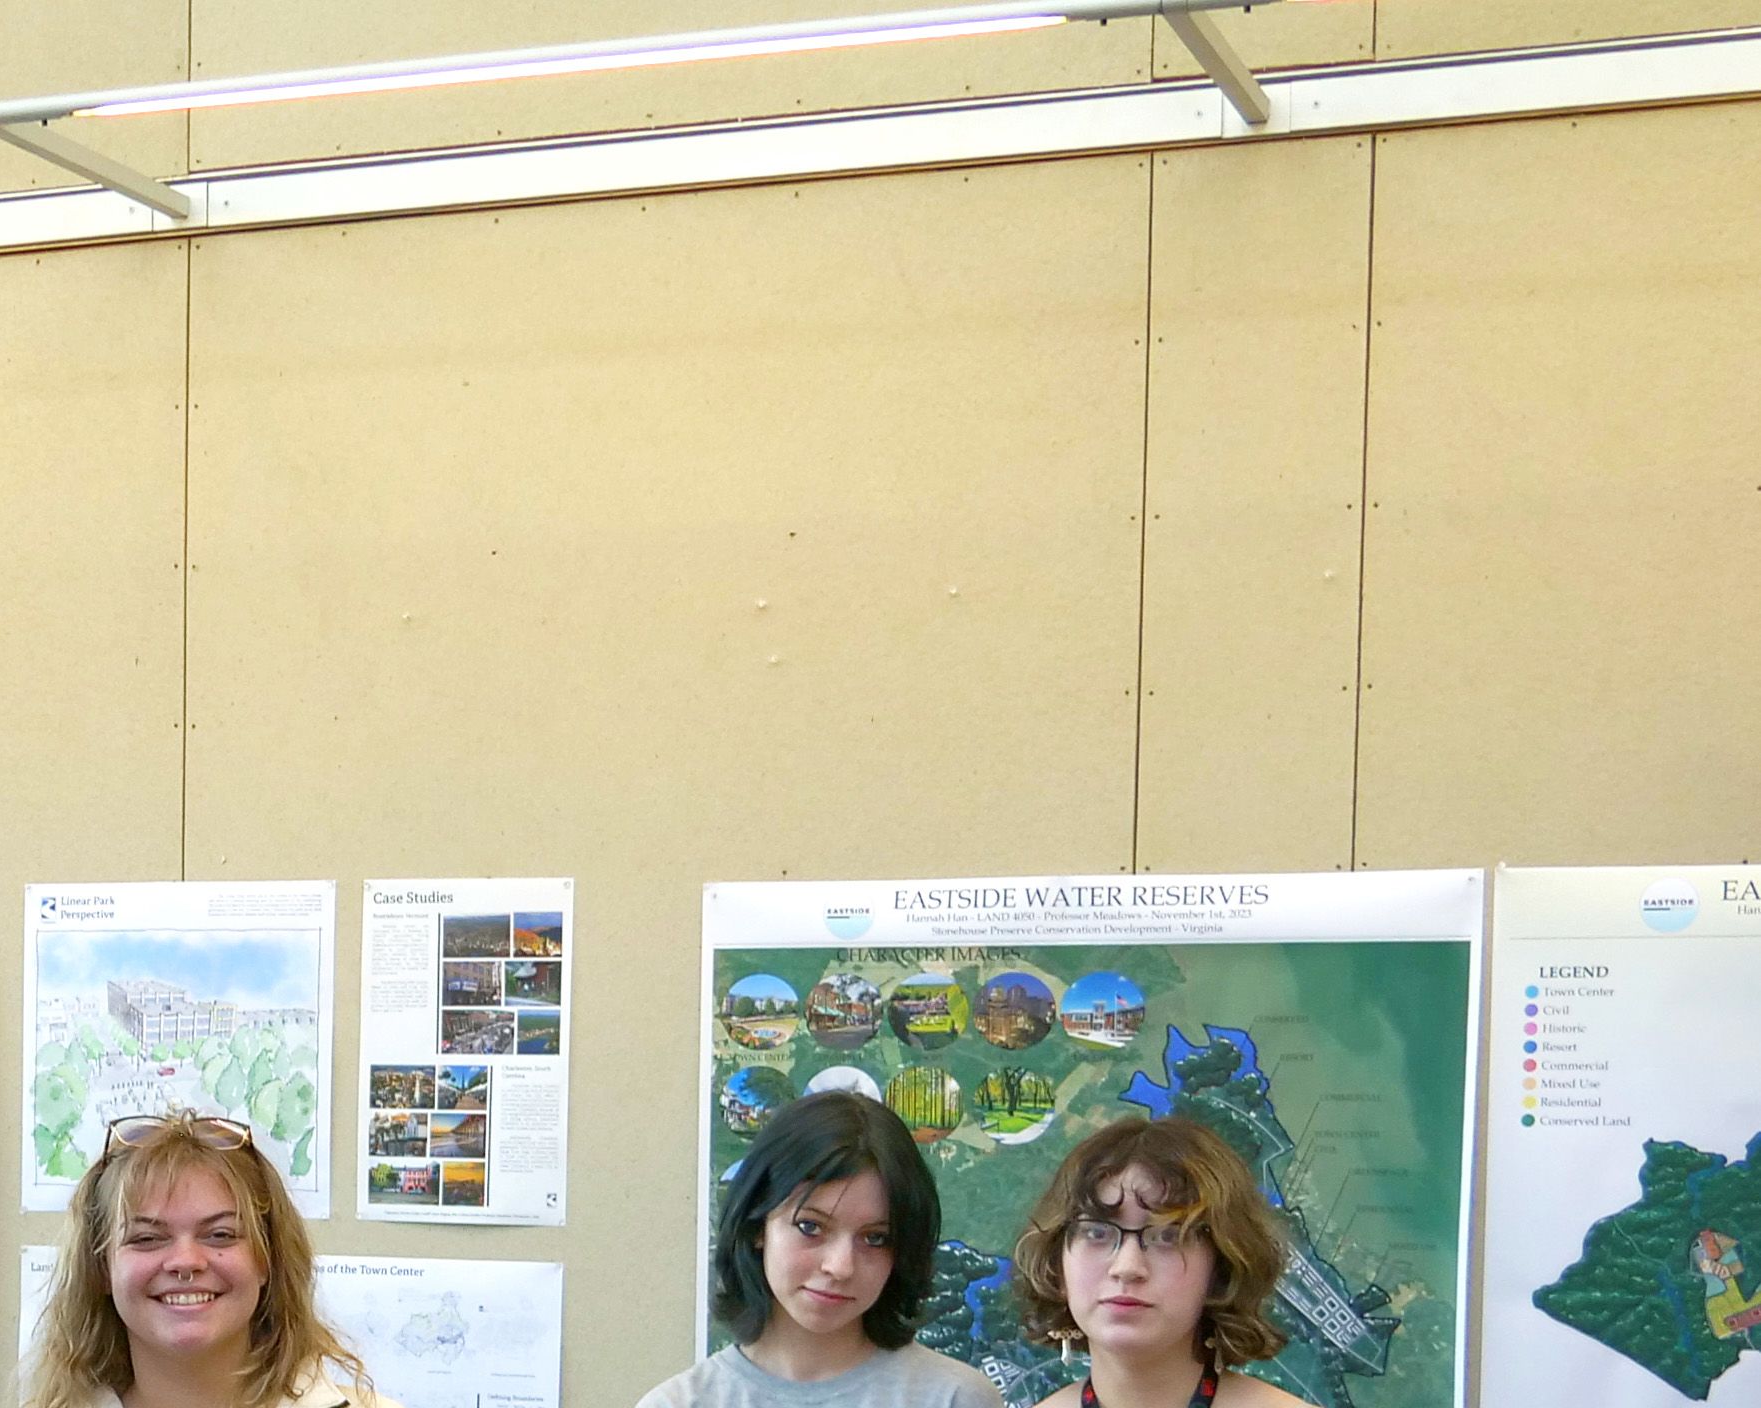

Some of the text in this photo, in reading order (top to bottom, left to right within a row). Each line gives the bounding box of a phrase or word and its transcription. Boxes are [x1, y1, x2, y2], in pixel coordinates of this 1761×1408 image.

[60, 896, 115, 906] Linear Park
[373, 890, 454, 905] Case Studies
[893, 884, 1270, 909] EASTSIDE WATER RESERVES
[60, 909, 115, 921] Perspective
[906, 909, 1252, 923] Hannah Han LAND 4050 Professor Meadows November 1st, 2023
[931, 923, 1223, 936] Stonehouse Preserve Conservation Development Virginia
[836, 948, 1021, 962] CHARACTER IMAGES
[1539, 966, 1609, 979] LEGEND
[1544, 987, 1615, 997] Town Center
[1542, 1005, 1570, 1015] Civil
[1542, 1023, 1587, 1033] Historic
[1542, 1042, 1577, 1052] Resort
[1541, 1060, 1609, 1071] Commercial
[1541, 1078, 1600, 1089] Mixed Use
[1540, 1097, 1602, 1108] Residential
[1539, 1115, 1631, 1126] Conserved Land
[327, 1263, 338, 1274] of
[340, 1263, 357, 1275] the
[359, 1264, 387, 1275] Town
[390, 1265, 425, 1277] Center
